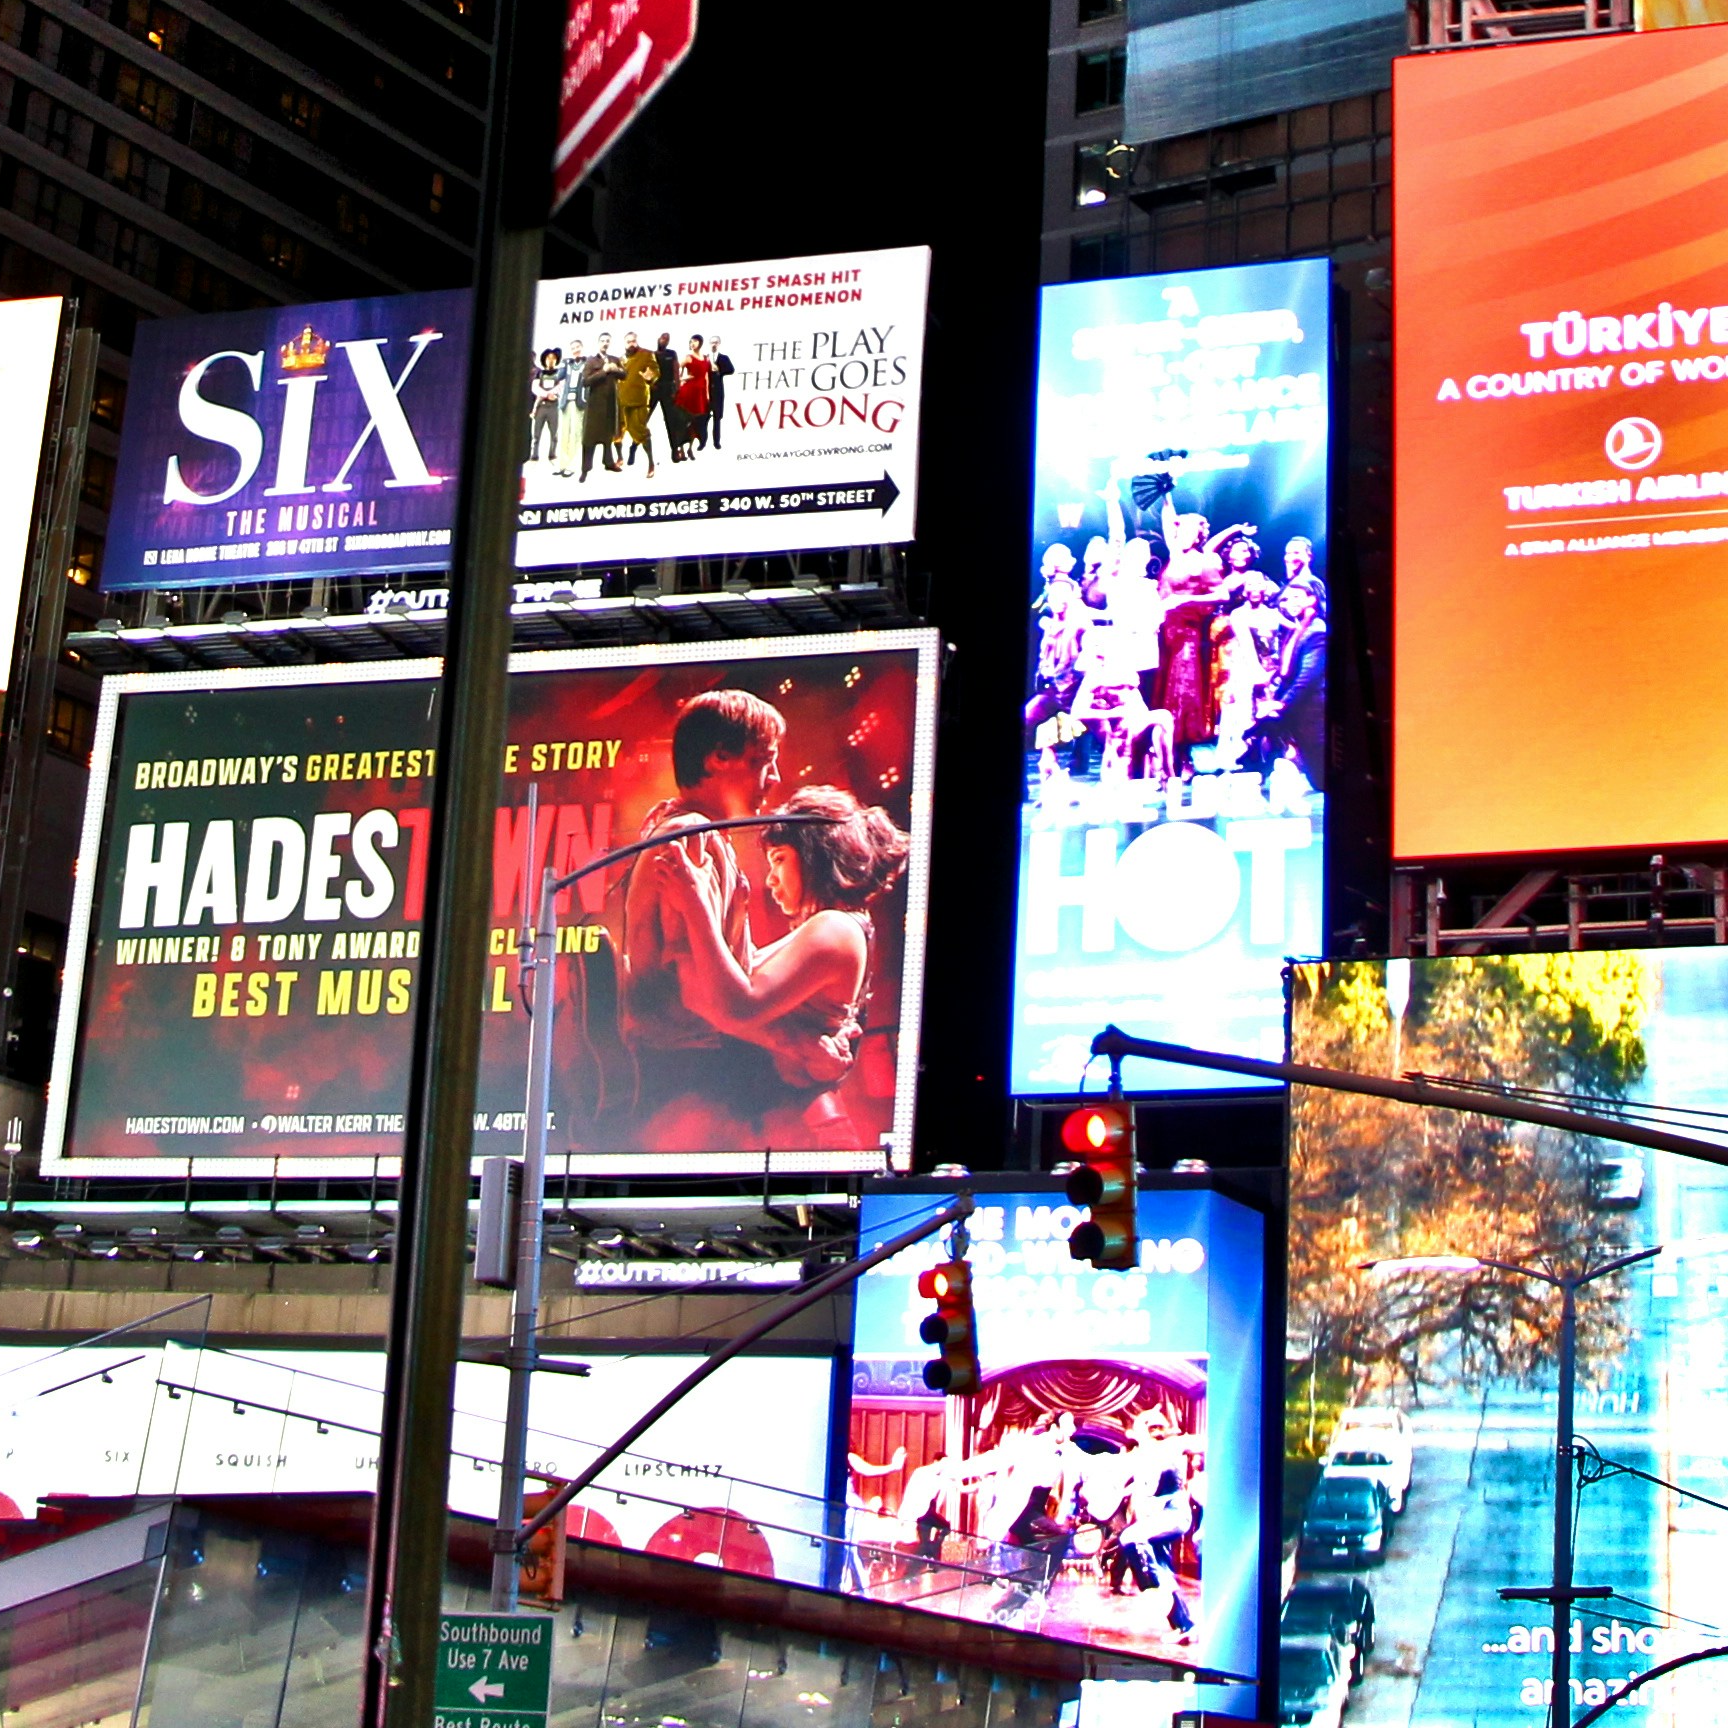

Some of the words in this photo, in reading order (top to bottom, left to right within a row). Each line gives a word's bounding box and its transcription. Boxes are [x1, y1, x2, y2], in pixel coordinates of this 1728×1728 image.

[565, 283, 672, 305] BROADWAY'S
[677, 276, 761, 295] FUNNIEST
[766, 272, 829, 289] SMASH
[831, 269, 862, 285] HIT
[559, 309, 595, 325] AND
[599, 297, 735, 321] INTERNATIONAL
[740, 288, 863, 310] PHENOMENON
[753, 340, 803, 362] THE
[811, 325, 895, 360] PLAY
[737, 368, 806, 392] THAT
[810, 356, 908, 392] GOES
[1436, 378, 1462, 402] A
[1467, 364, 1614, 399] COUNTRY
[1620, 360, 1664, 387] OF
[163, 330, 444, 506] SIX
[735, 392, 906, 433] WRONG
[546, 507, 586, 524] NEW
[587, 503, 646, 522] WORLD
[649, 499, 709, 517] STAGES
[719, 496, 751, 513] 340
[754, 495, 775, 511] W.
[779, 491, 815, 509] 50TH
[817, 489, 875, 506] STREET
[1503, 478, 1631, 511] TURKISH
[226, 509, 266, 536] THE
[278, 501, 378, 532] MUSICAL
[1567, 534, 1651, 552] ALLIANCE
[135, 755, 299, 790] BROADWAY'S
[530, 739, 623, 772] STORY
[1025, 818, 1313, 956] HOT
[116, 937, 221, 966] WINNER!
[230, 934, 245, 962] 8
[257, 933, 322, 962] TONY
[331, 930, 420, 960] AWARD
[192, 972, 298, 1018] BEST
[126, 1115, 244, 1135] HADESTOWN.COM
[278, 1114, 332, 1133] WALTER
[335, 1114, 371, 1133] KERR
[104, 1450, 131, 1463] SIX
[215, 1453, 288, 1468] SQUISH
[624, 1463, 722, 1478] LIPSCHITZ
[440, 1621, 541, 1644] Southbound
[447, 1648, 476, 1669] Use
[482, 1649, 492, 1669] 7
[498, 1650, 529, 1671] Ave
[434, 1715, 471, 1728] Best
